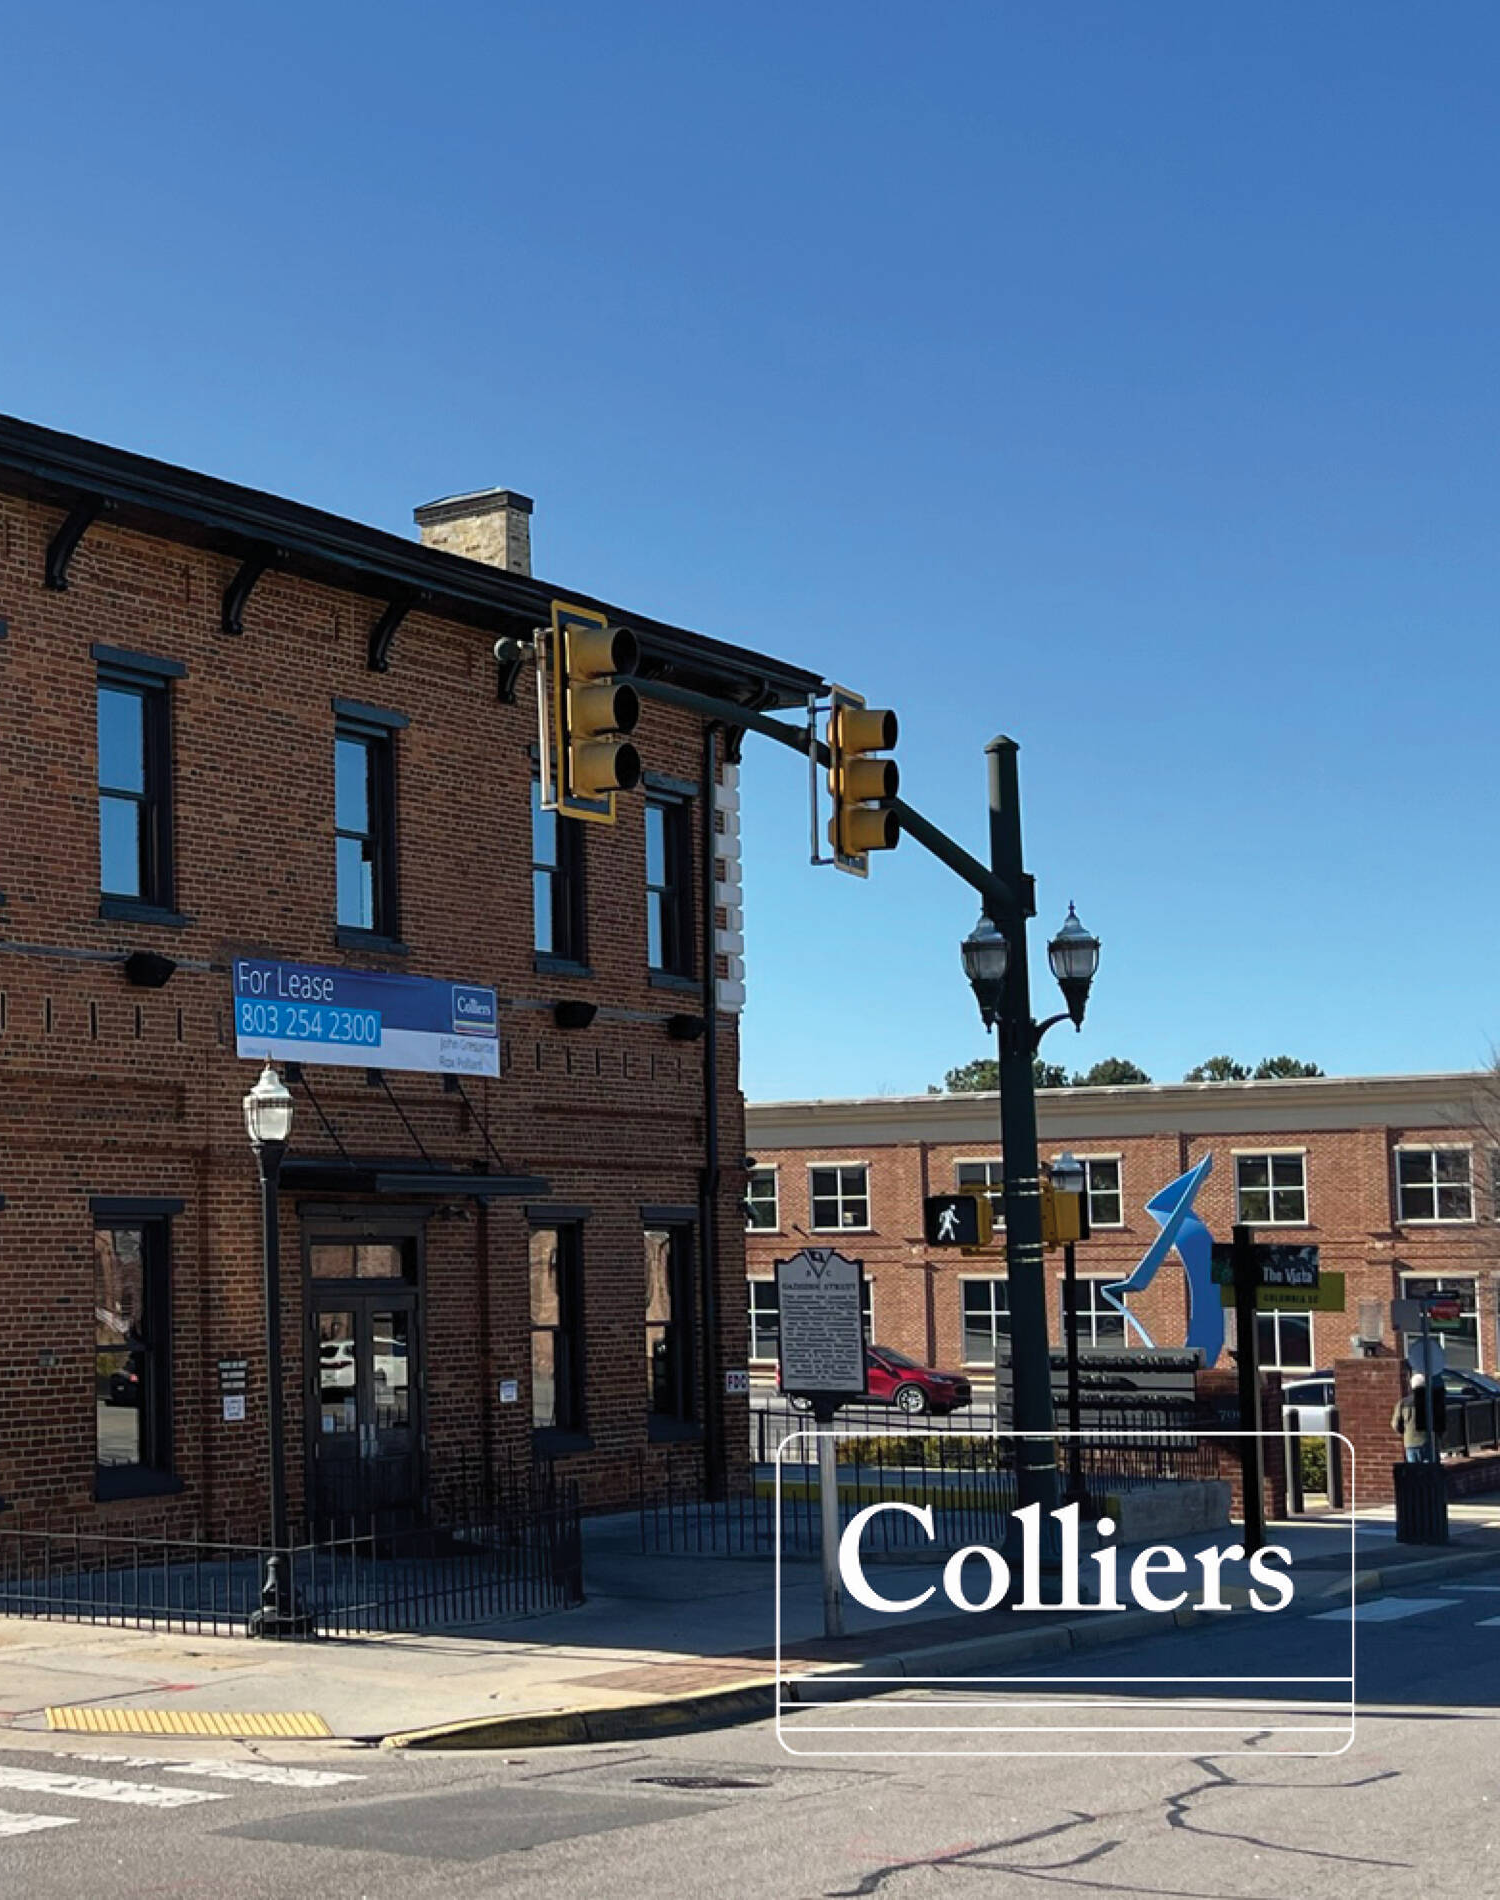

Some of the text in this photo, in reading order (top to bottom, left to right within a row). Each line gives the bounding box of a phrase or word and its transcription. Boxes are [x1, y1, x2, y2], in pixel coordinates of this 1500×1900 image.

[238, 962, 334, 1001] For Lease
[241, 1003, 376, 1042] 803 254 2300
[1262, 1266, 1282, 1282] The
